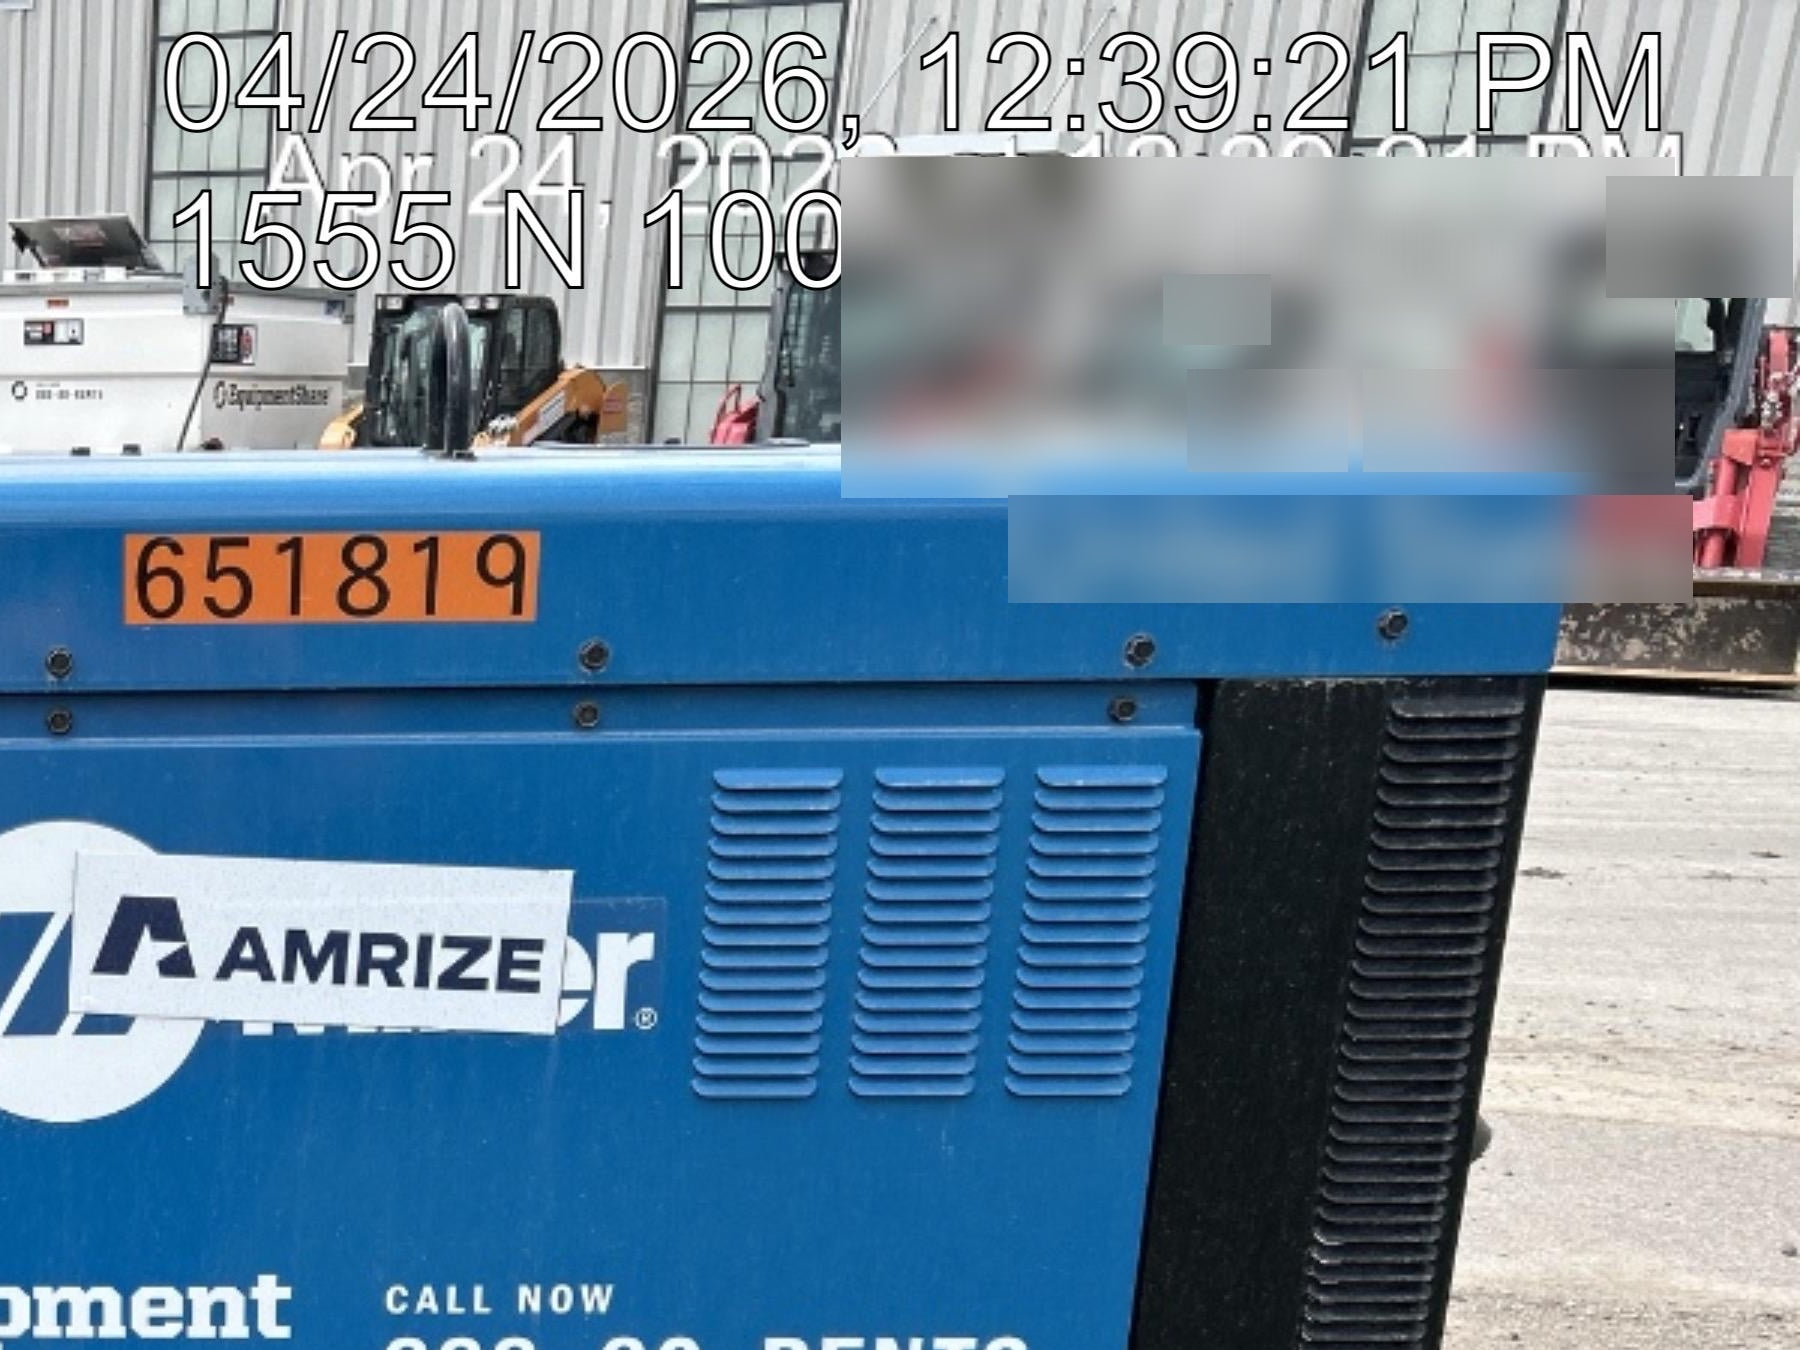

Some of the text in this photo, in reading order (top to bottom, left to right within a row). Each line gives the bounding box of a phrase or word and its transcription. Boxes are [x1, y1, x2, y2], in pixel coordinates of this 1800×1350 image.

[136, 534, 526, 619] 651819
[216, 926, 547, 994] AMRIZE
[385, 1283, 615, 1315] CALL NOW
